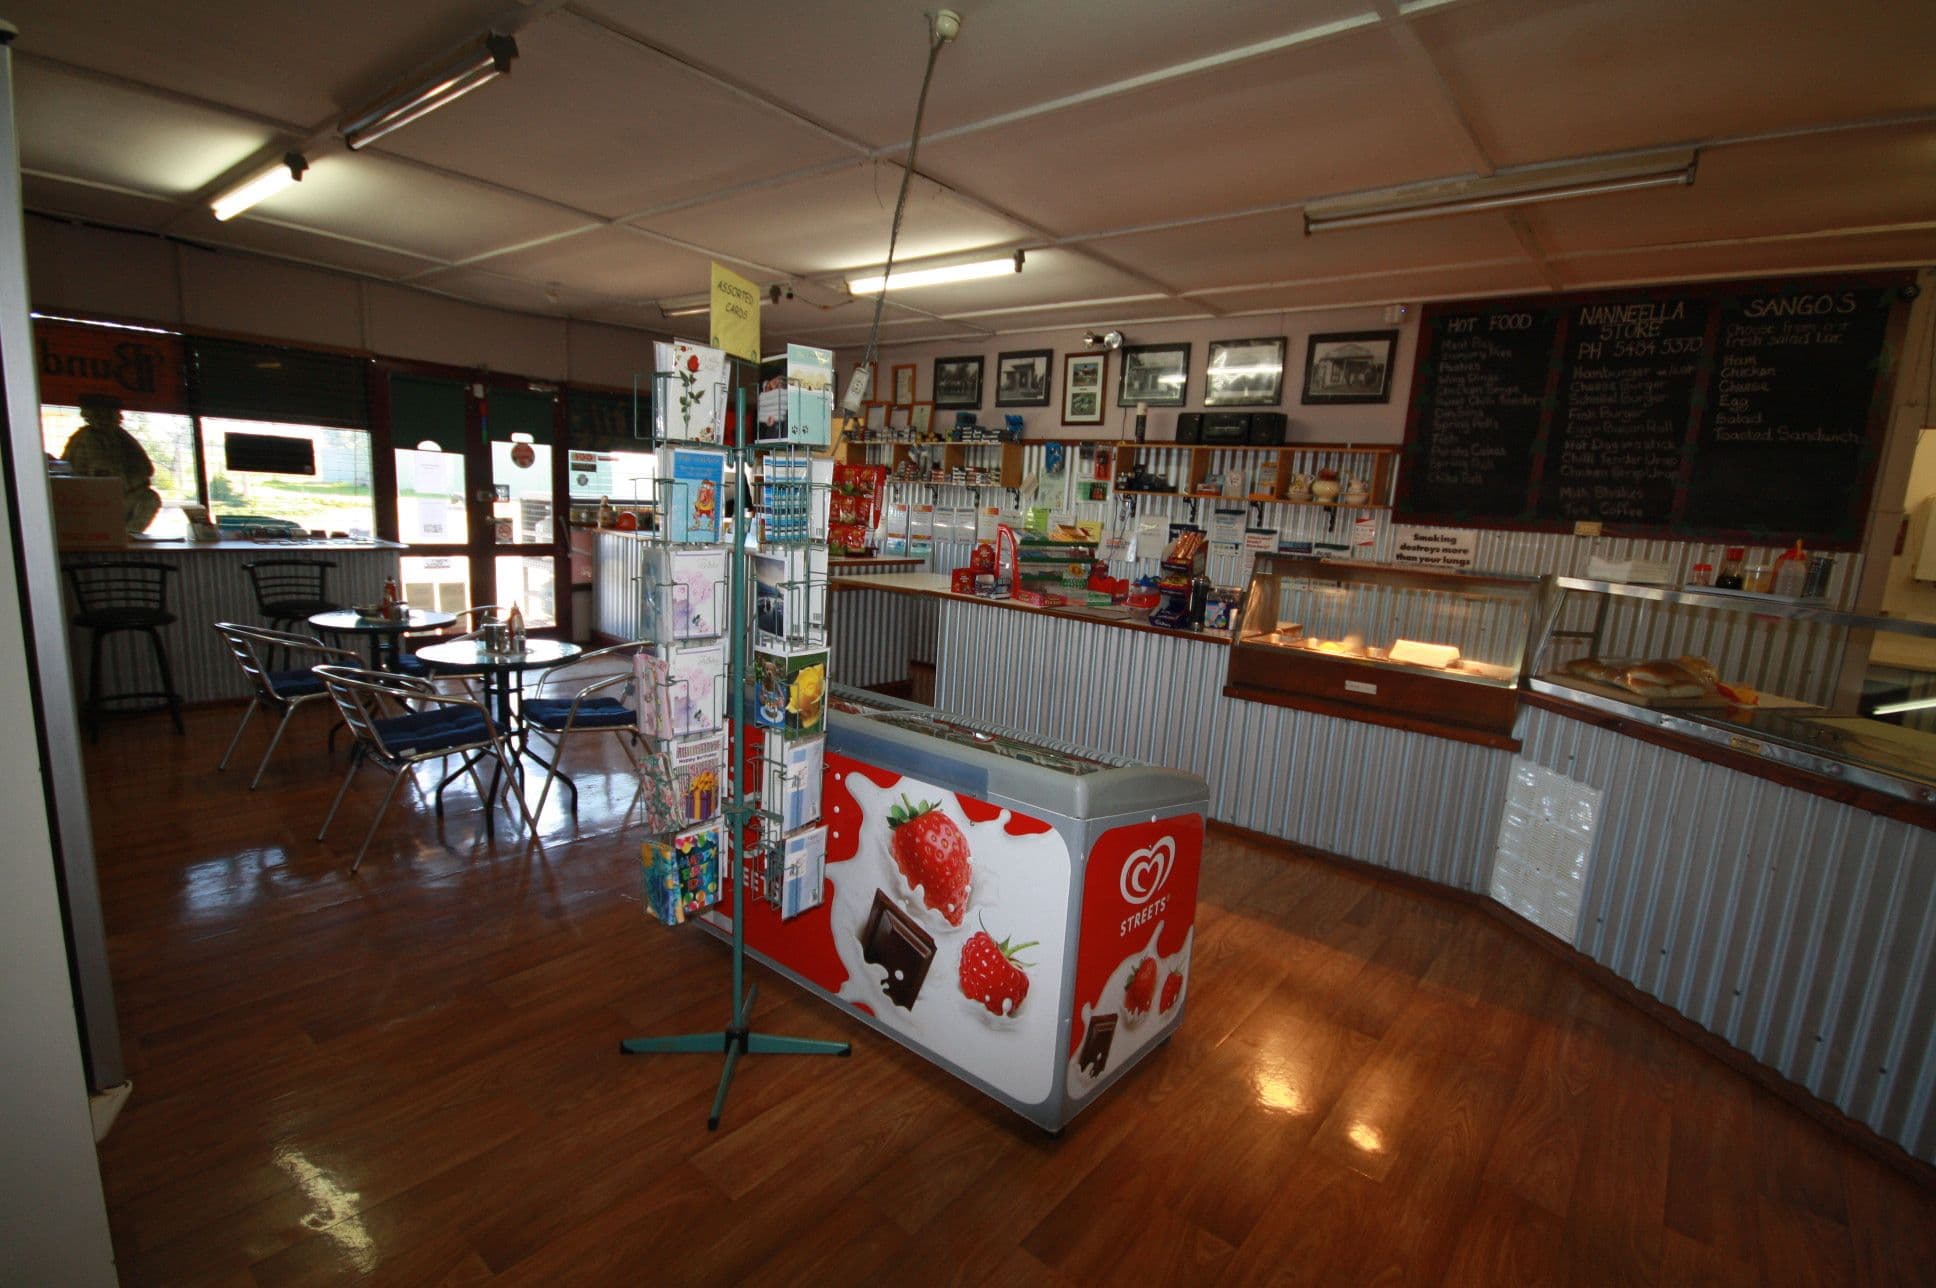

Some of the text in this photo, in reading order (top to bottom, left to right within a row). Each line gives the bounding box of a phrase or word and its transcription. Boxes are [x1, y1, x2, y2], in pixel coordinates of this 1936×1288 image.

[717, 281, 754, 305] ASSORTED
[725, 302, 749, 320] CARDS
[1447, 313, 1534, 334] HOT FOOD
[1600, 321, 1662, 342] STORE
[1577, 342, 1603, 360] PH
[1720, 367, 1777, 378] Chicken
[1719, 394, 1751, 413] Egg
[1413, 532, 1457, 545] Smoking
[1399, 543, 1470, 555] destroys more
[1396, 552, 1418, 562] than
[1418, 555, 1442, 564] your
[1443, 556, 1472, 567] lungs
[1120, 895, 1167, 937] STREETS
